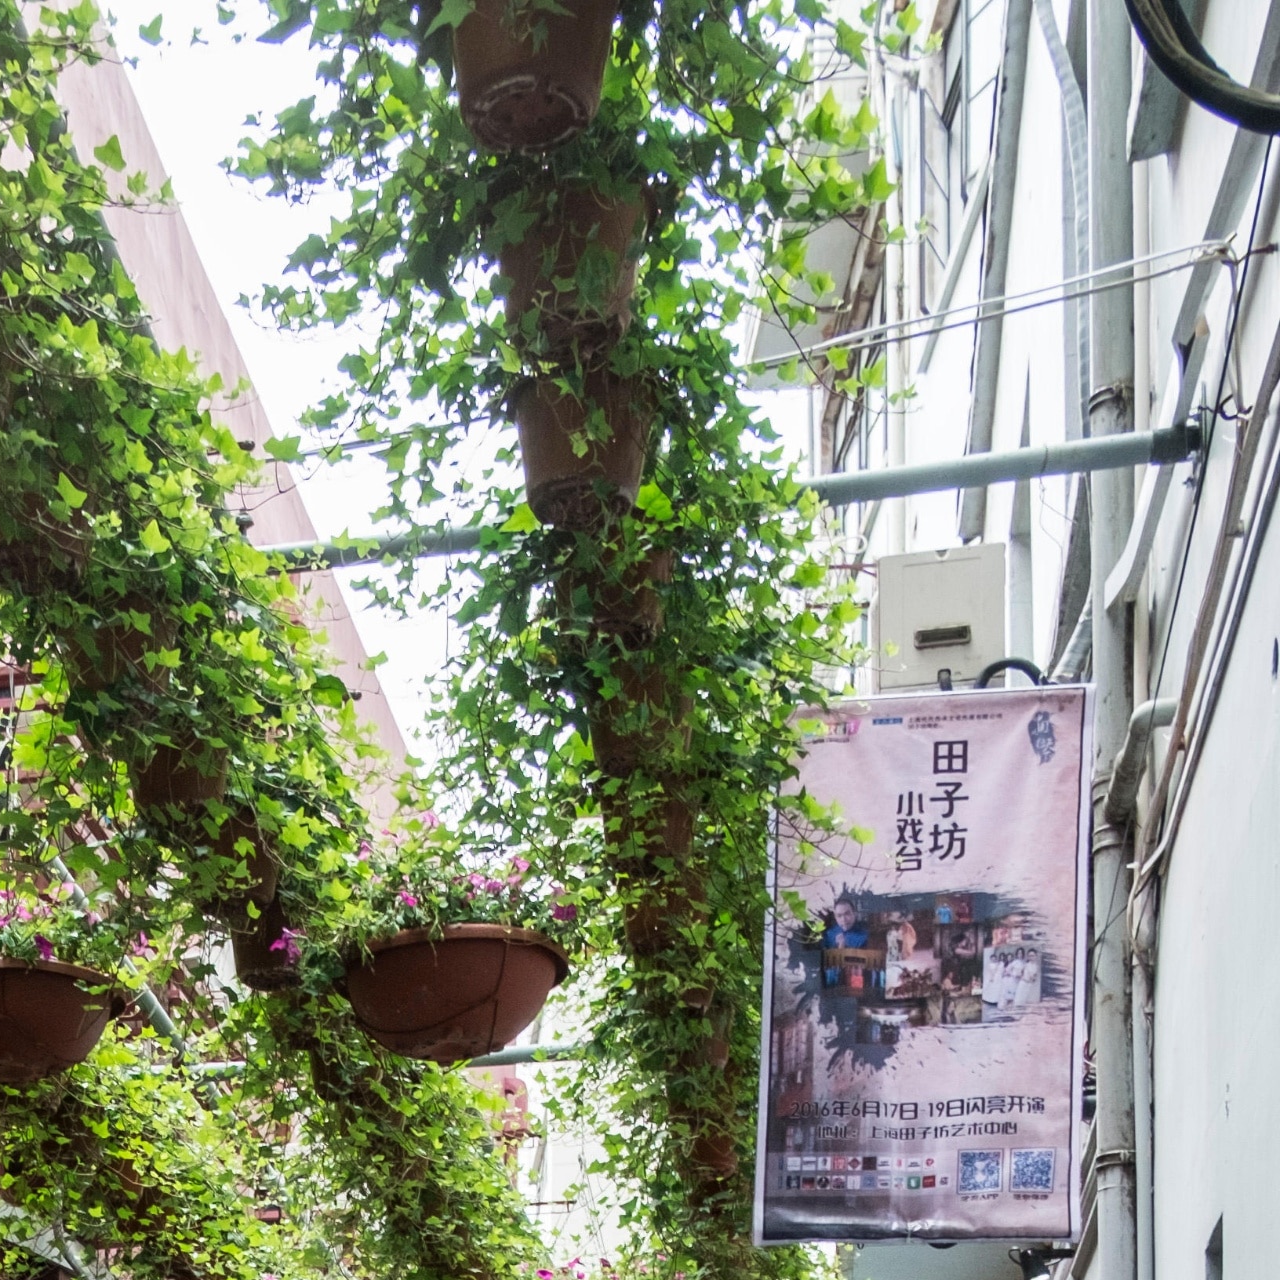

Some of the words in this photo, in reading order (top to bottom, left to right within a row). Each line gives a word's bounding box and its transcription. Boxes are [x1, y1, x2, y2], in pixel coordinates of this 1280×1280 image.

[896, 790, 925, 873] 小戏台
[929, 739, 970, 861] 田子坊
